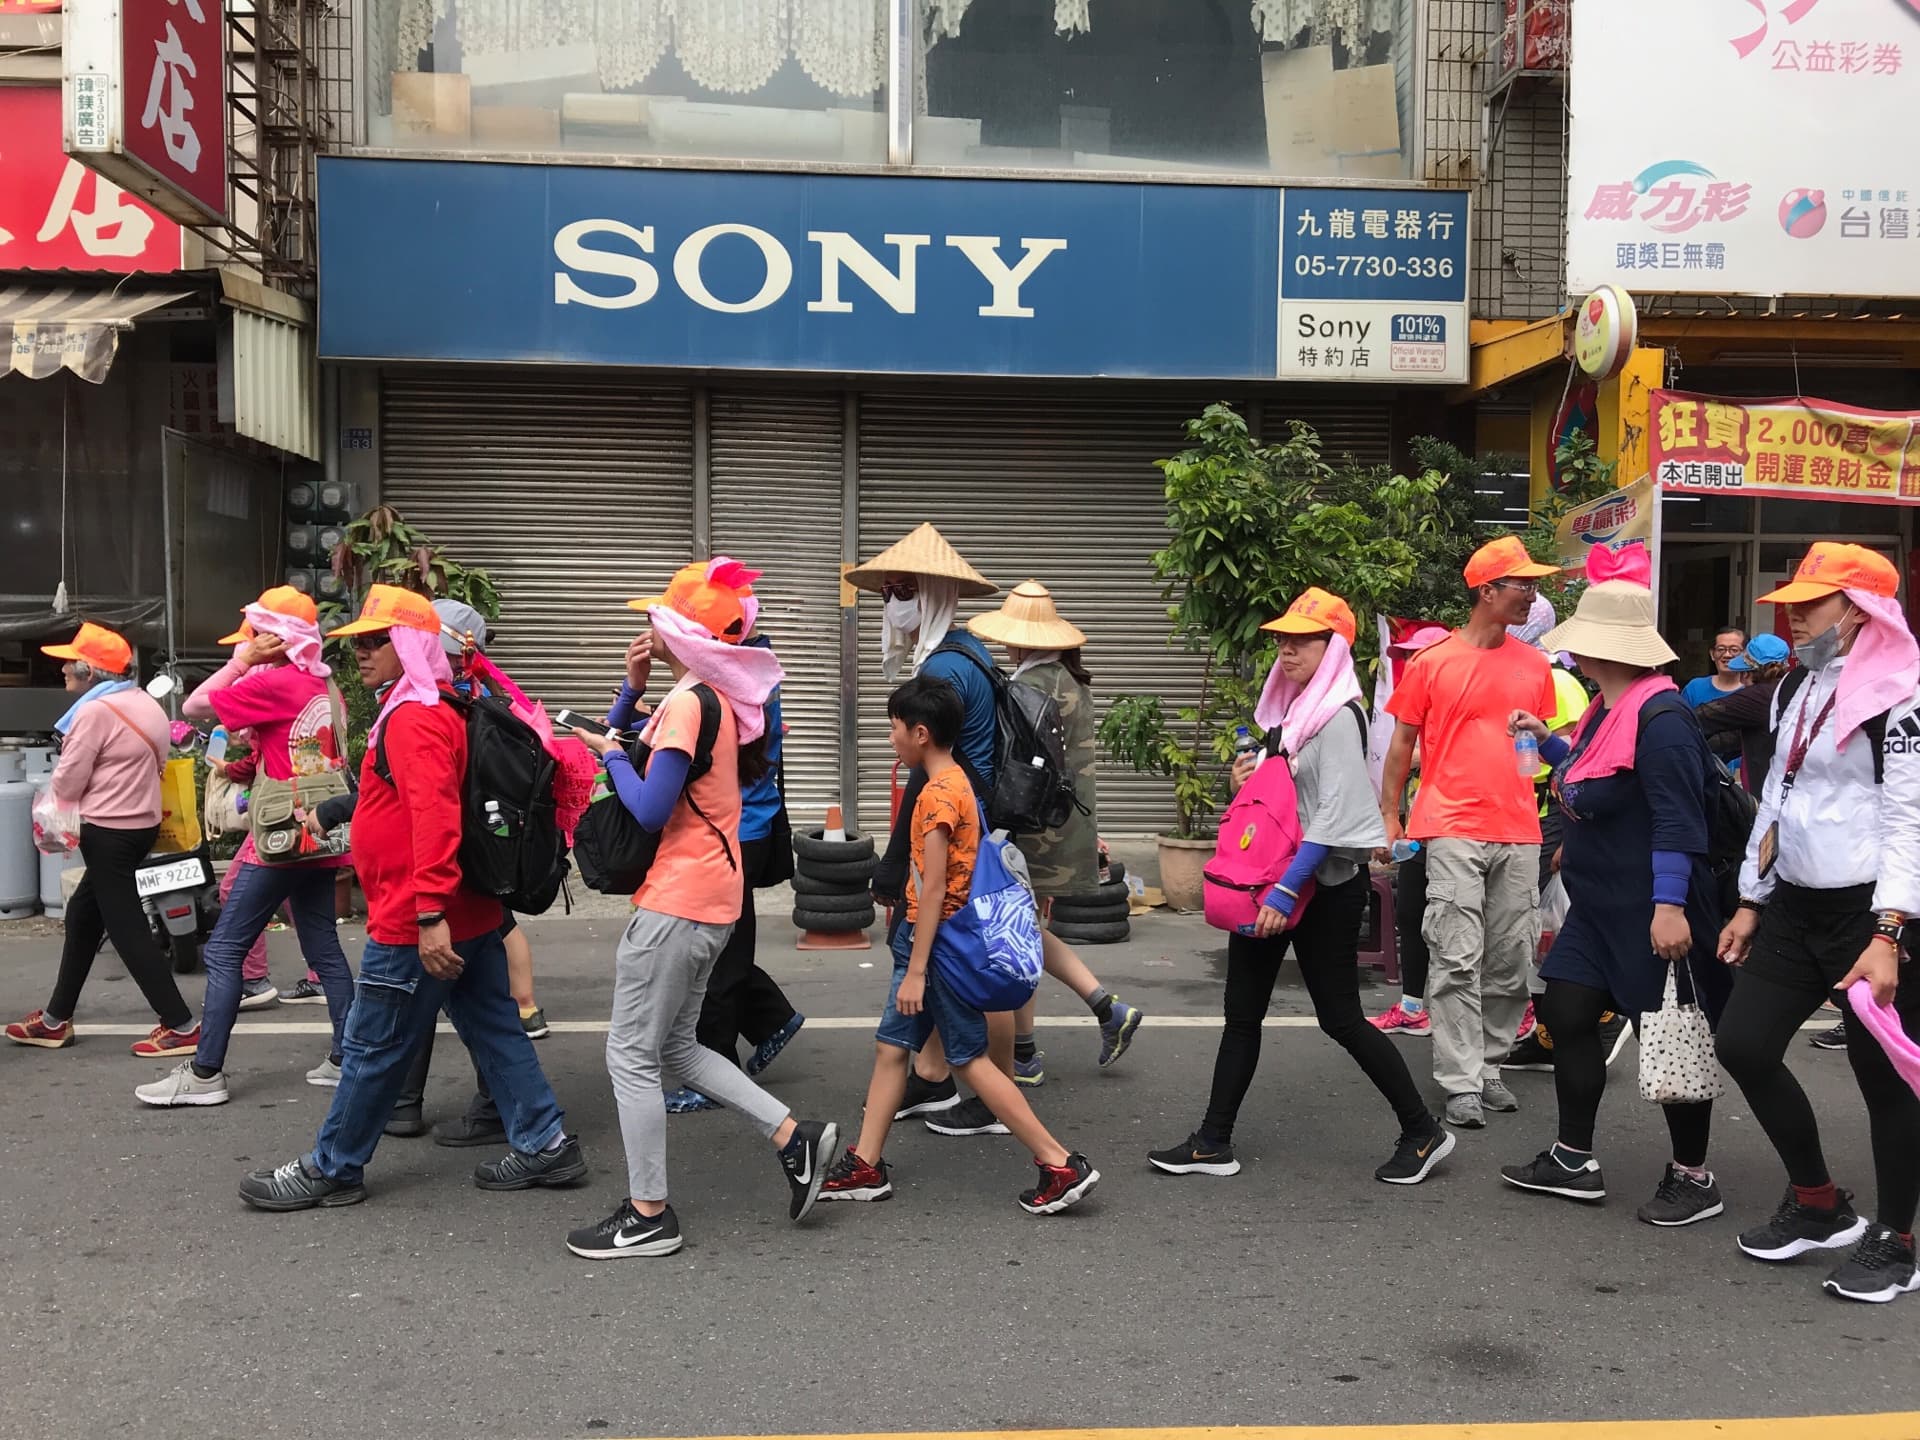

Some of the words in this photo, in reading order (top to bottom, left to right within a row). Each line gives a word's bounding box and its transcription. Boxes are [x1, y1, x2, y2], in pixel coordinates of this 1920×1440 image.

[1771, 40, 1903, 75] 公益彩券
[141, 0, 205, 173] 店
[0, 156, 154, 257] 店
[1584, 181, 1752, 222] 威力彩
[1842, 189, 1909, 202] 中國信託
[1296, 208, 1455, 240] 九龍電器行
[1840, 206, 1920, 240] 台灣
[553, 218, 1068, 319] SONY
[1295, 255, 1454, 279] 05-7730-336
[1616, 242, 1726, 270] 頭獎巨無霸
[1298, 313, 1372, 343] Sony
[1397, 316, 1440, 334] 101%
[1298, 346, 1371, 368] 特約店
[1659, 401, 1744, 457] 狂賀
[1662, 462, 1742, 486] 本店開出
[1755, 451, 1893, 490] 開運發財金
[1571, 498, 1637, 536] 雙贏彩
